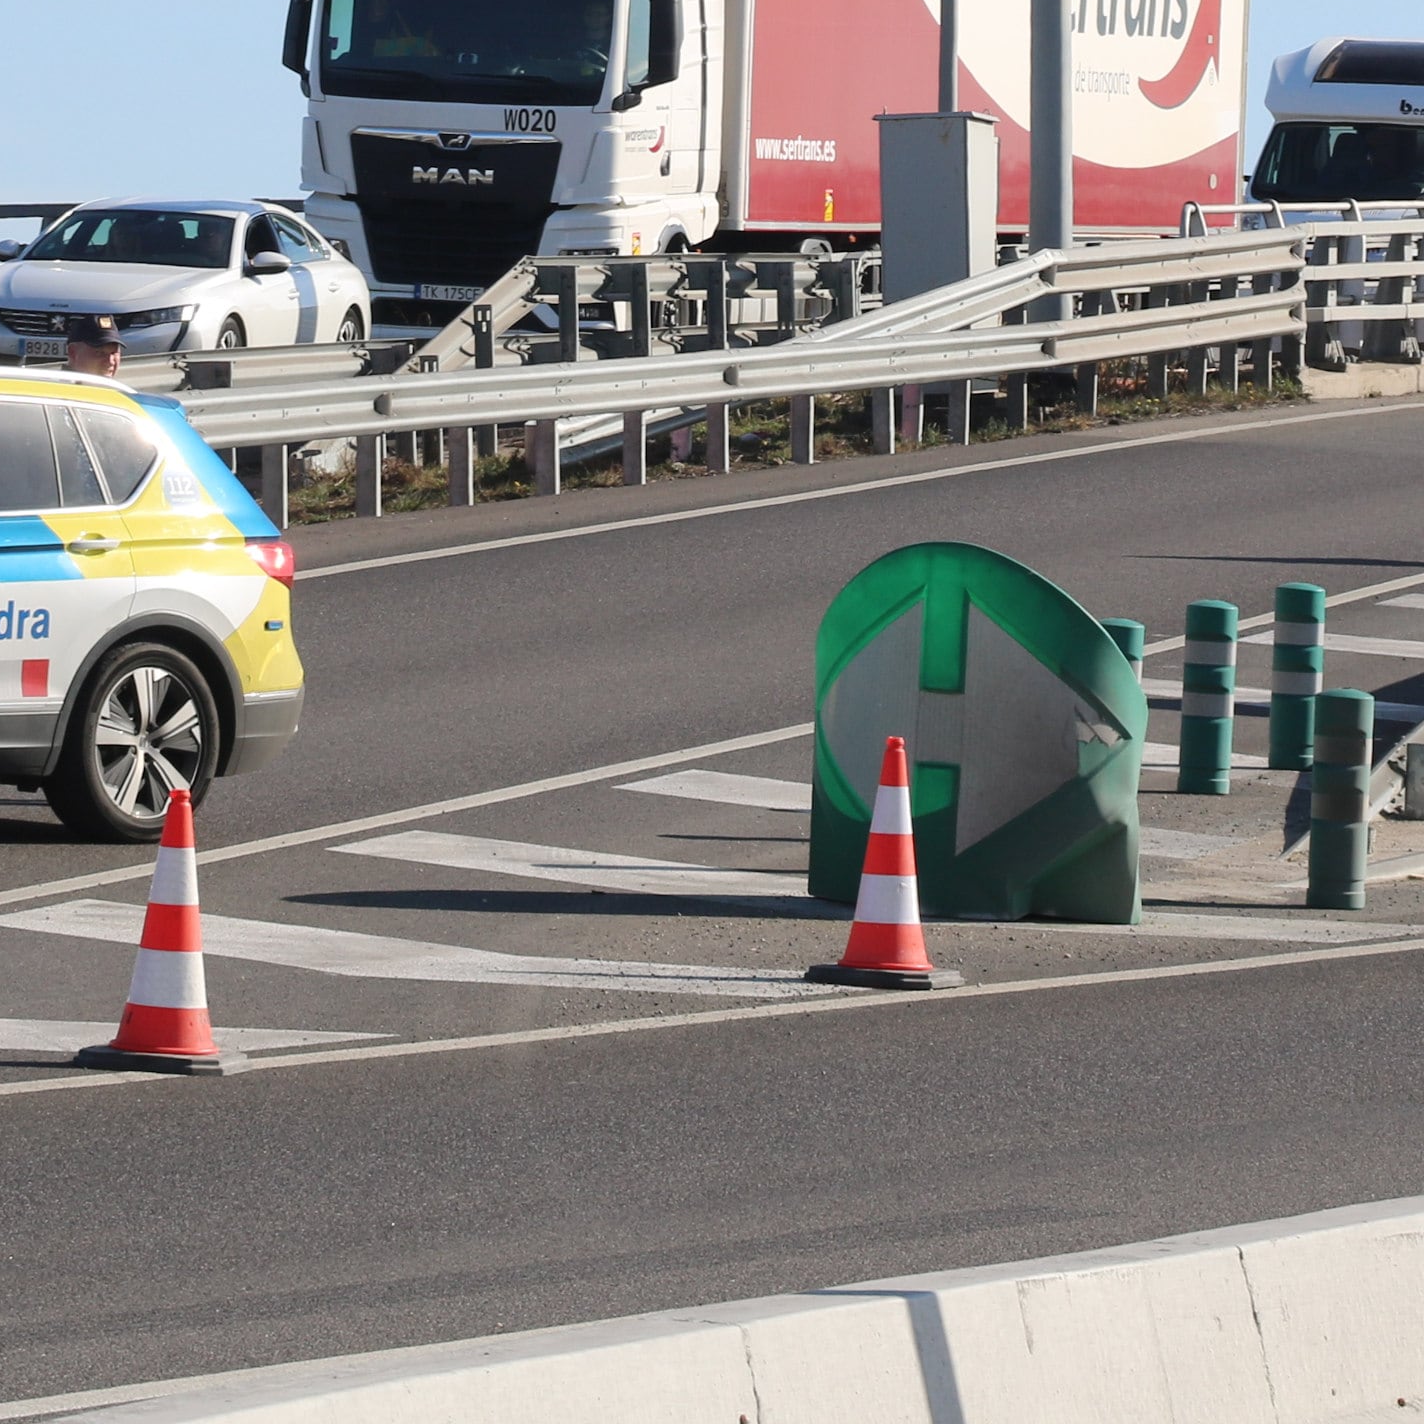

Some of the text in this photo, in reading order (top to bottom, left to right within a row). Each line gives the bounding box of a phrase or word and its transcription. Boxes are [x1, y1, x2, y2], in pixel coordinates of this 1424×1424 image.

[504, 108, 557, 132] W020
[755, 134, 837, 162] www.sertrans.es
[412, 166, 495, 185] MAN
[166, 476, 195, 495] 112
